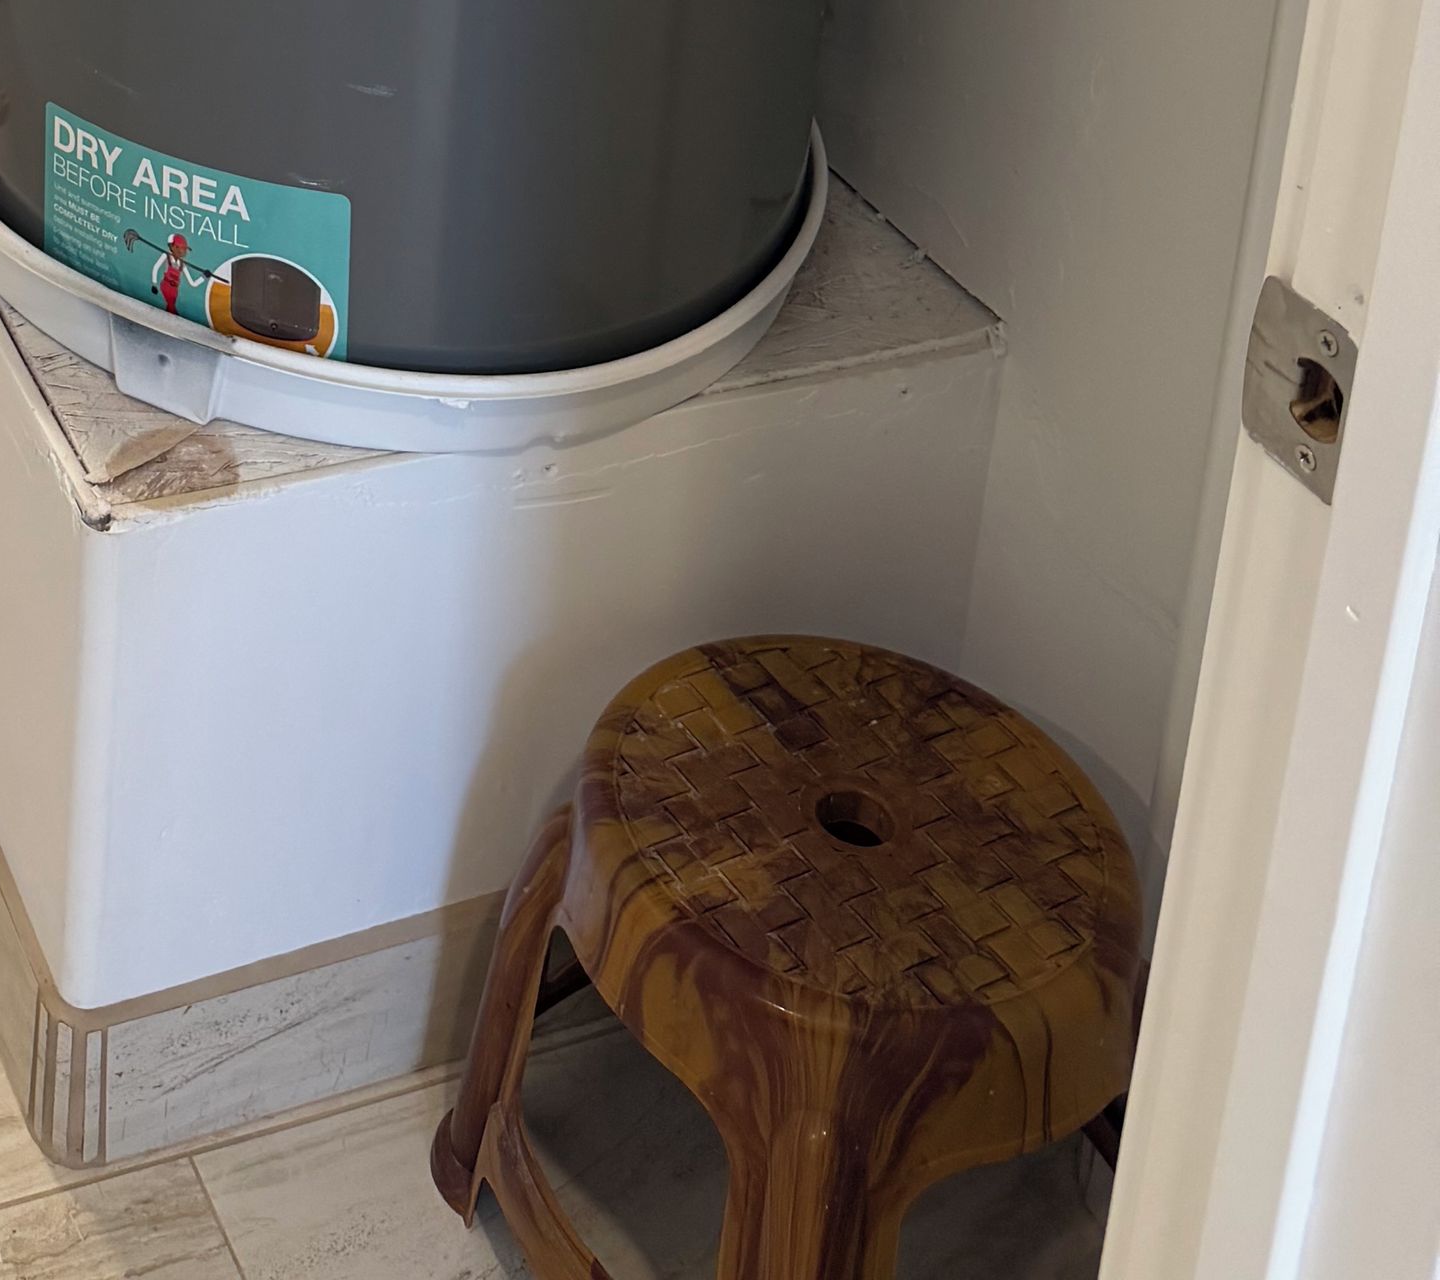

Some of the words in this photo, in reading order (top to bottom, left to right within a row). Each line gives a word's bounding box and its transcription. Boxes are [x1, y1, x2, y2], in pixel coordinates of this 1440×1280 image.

[53, 153, 137, 214] BEFORE
[144, 196, 250, 248] INSTALL
[54, 116, 122, 176] DRY
[132, 158, 250, 222] AREA
[54, 203, 100, 234] COMPLETELY
[101, 229, 118, 243] DRY
[68, 200, 88, 216] MUST
[90, 213, 100, 223] BE
